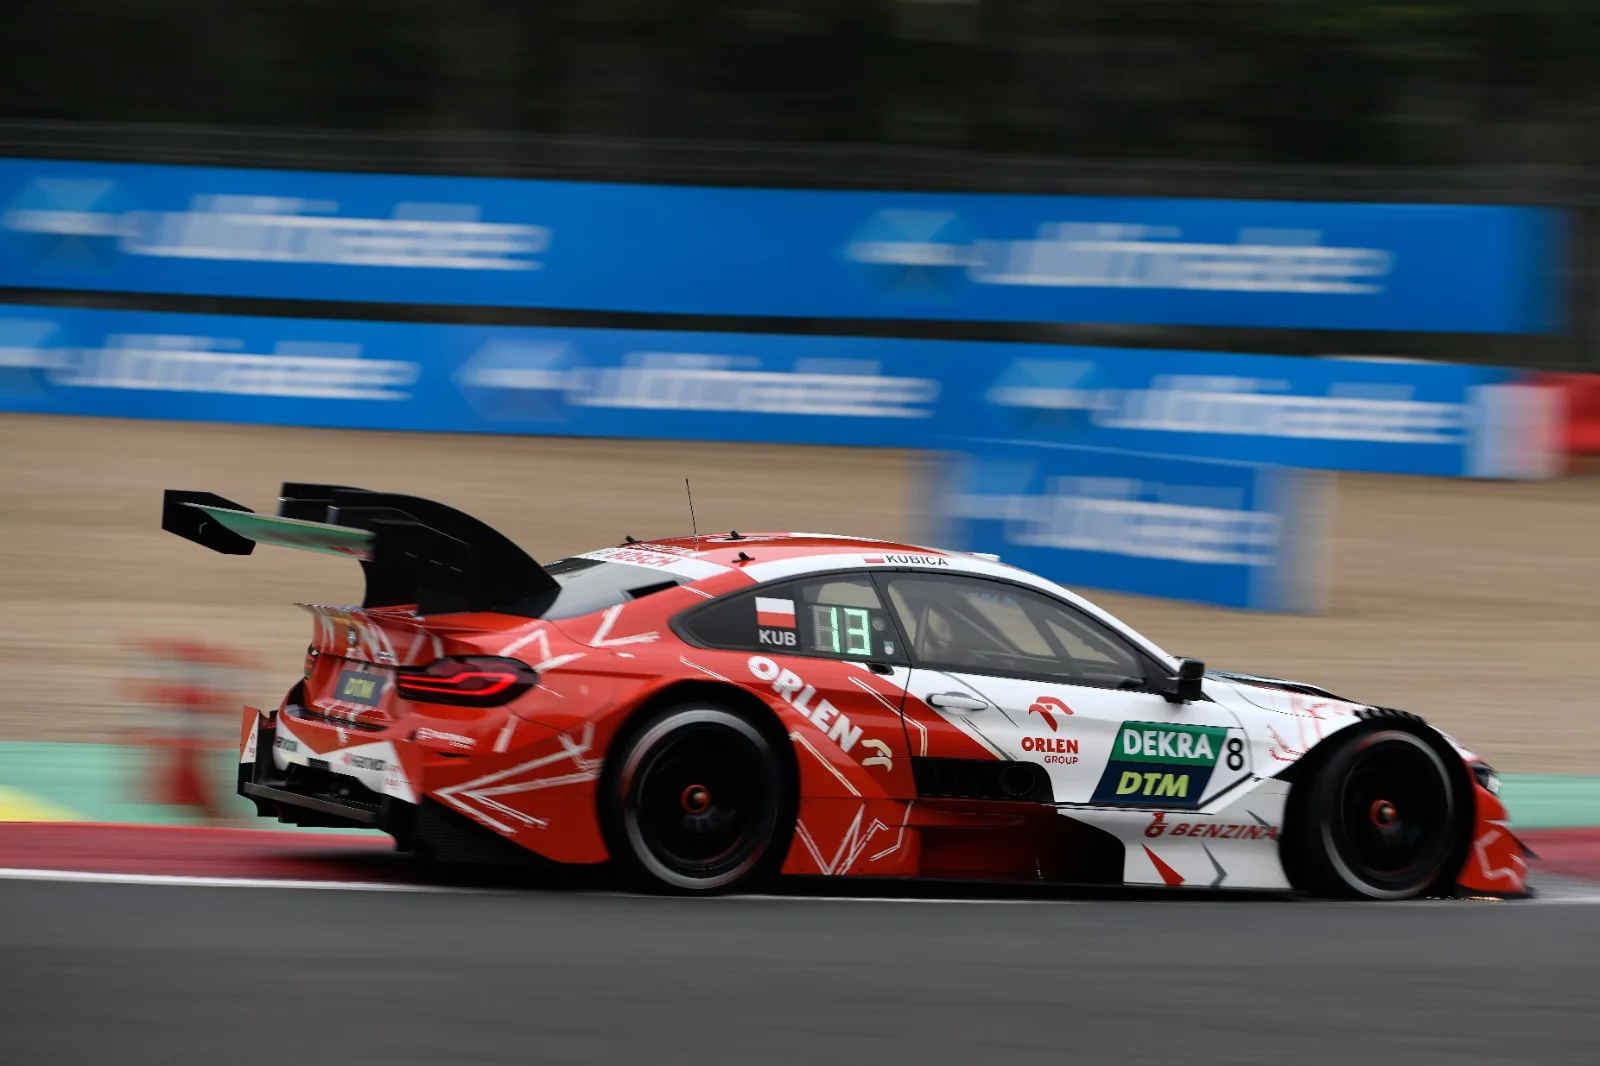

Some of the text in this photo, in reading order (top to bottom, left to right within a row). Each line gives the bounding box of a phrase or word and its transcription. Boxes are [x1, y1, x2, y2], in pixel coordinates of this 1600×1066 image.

[886, 555, 949, 566] KUBICA
[758, 629, 797, 646] KUB
[829, 606, 872, 656] 13
[748, 656, 863, 753] ORLEN
[1021, 736, 1079, 755] ORLEN
[1123, 728, 1214, 760] DEKRA
[1225, 737, 1244, 771] 8
[1044, 754, 1079, 765] GROUP
[1116, 772, 1189, 797] DTM
[1169, 823, 1279, 840] BENZINA
